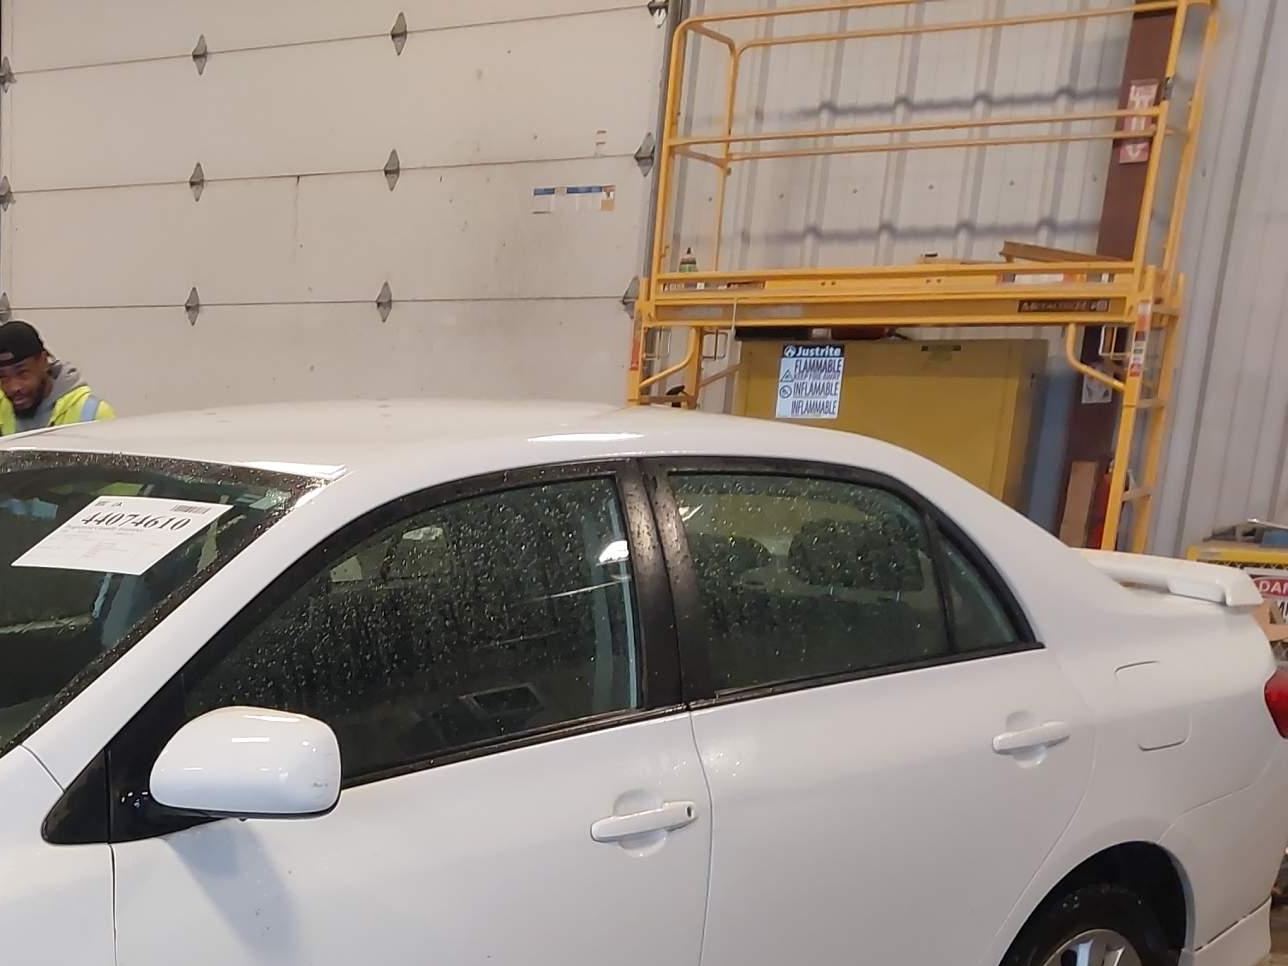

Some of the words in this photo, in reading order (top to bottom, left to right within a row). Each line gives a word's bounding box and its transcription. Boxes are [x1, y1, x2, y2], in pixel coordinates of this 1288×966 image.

[796, 345, 842, 357] Justrite
[794, 359, 842, 373] FLAMMABLE
[793, 381, 839, 396] INFLAMABLE
[791, 399, 838, 415] INFLAMMABLE
[81, 511, 192, 531] 44074610
